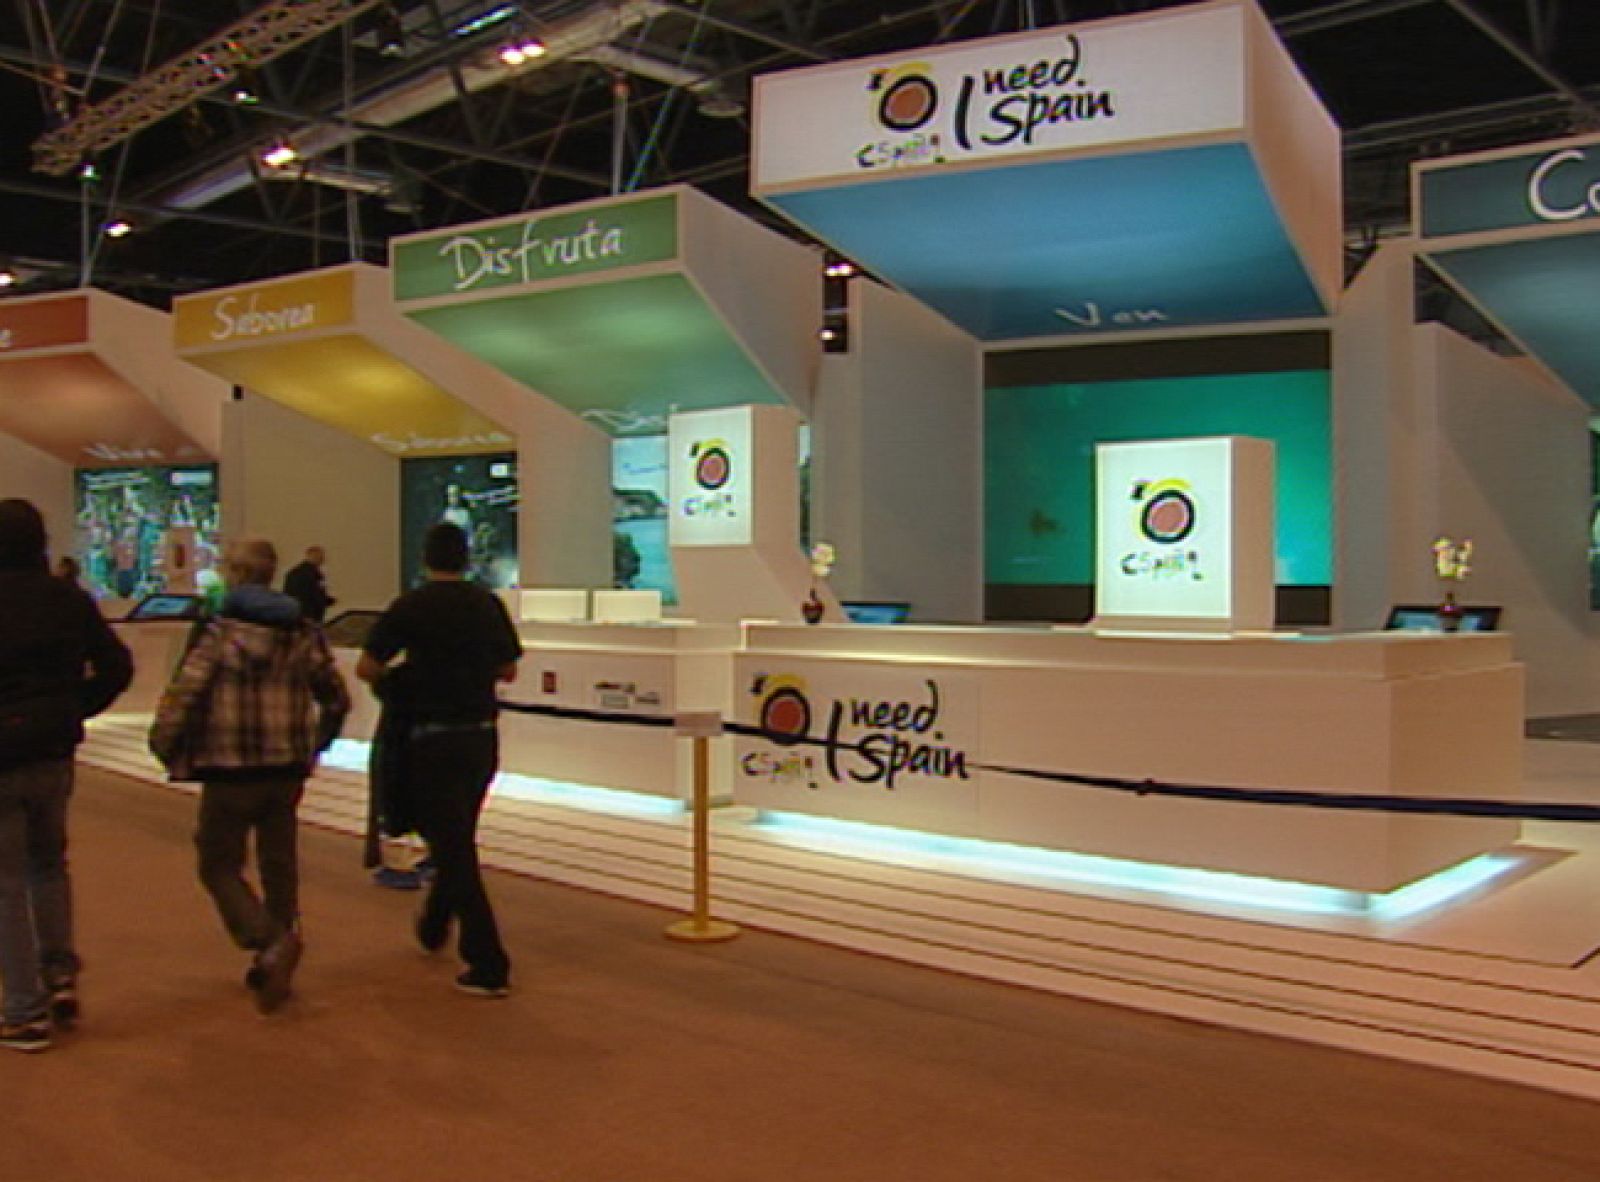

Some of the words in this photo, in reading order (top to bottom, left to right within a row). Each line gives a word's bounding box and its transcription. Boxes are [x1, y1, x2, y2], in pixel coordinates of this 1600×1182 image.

[954, 75, 976, 150] I
[982, 34, 1081, 95] need
[980, 78, 1115, 145] Spain
[438, 218, 624, 290] Disfruta
[210, 293, 317, 341] Saborea
[1054, 301, 1168, 328] Ven
[851, 678, 940, 732] need
[847, 731, 969, 790] Spain
